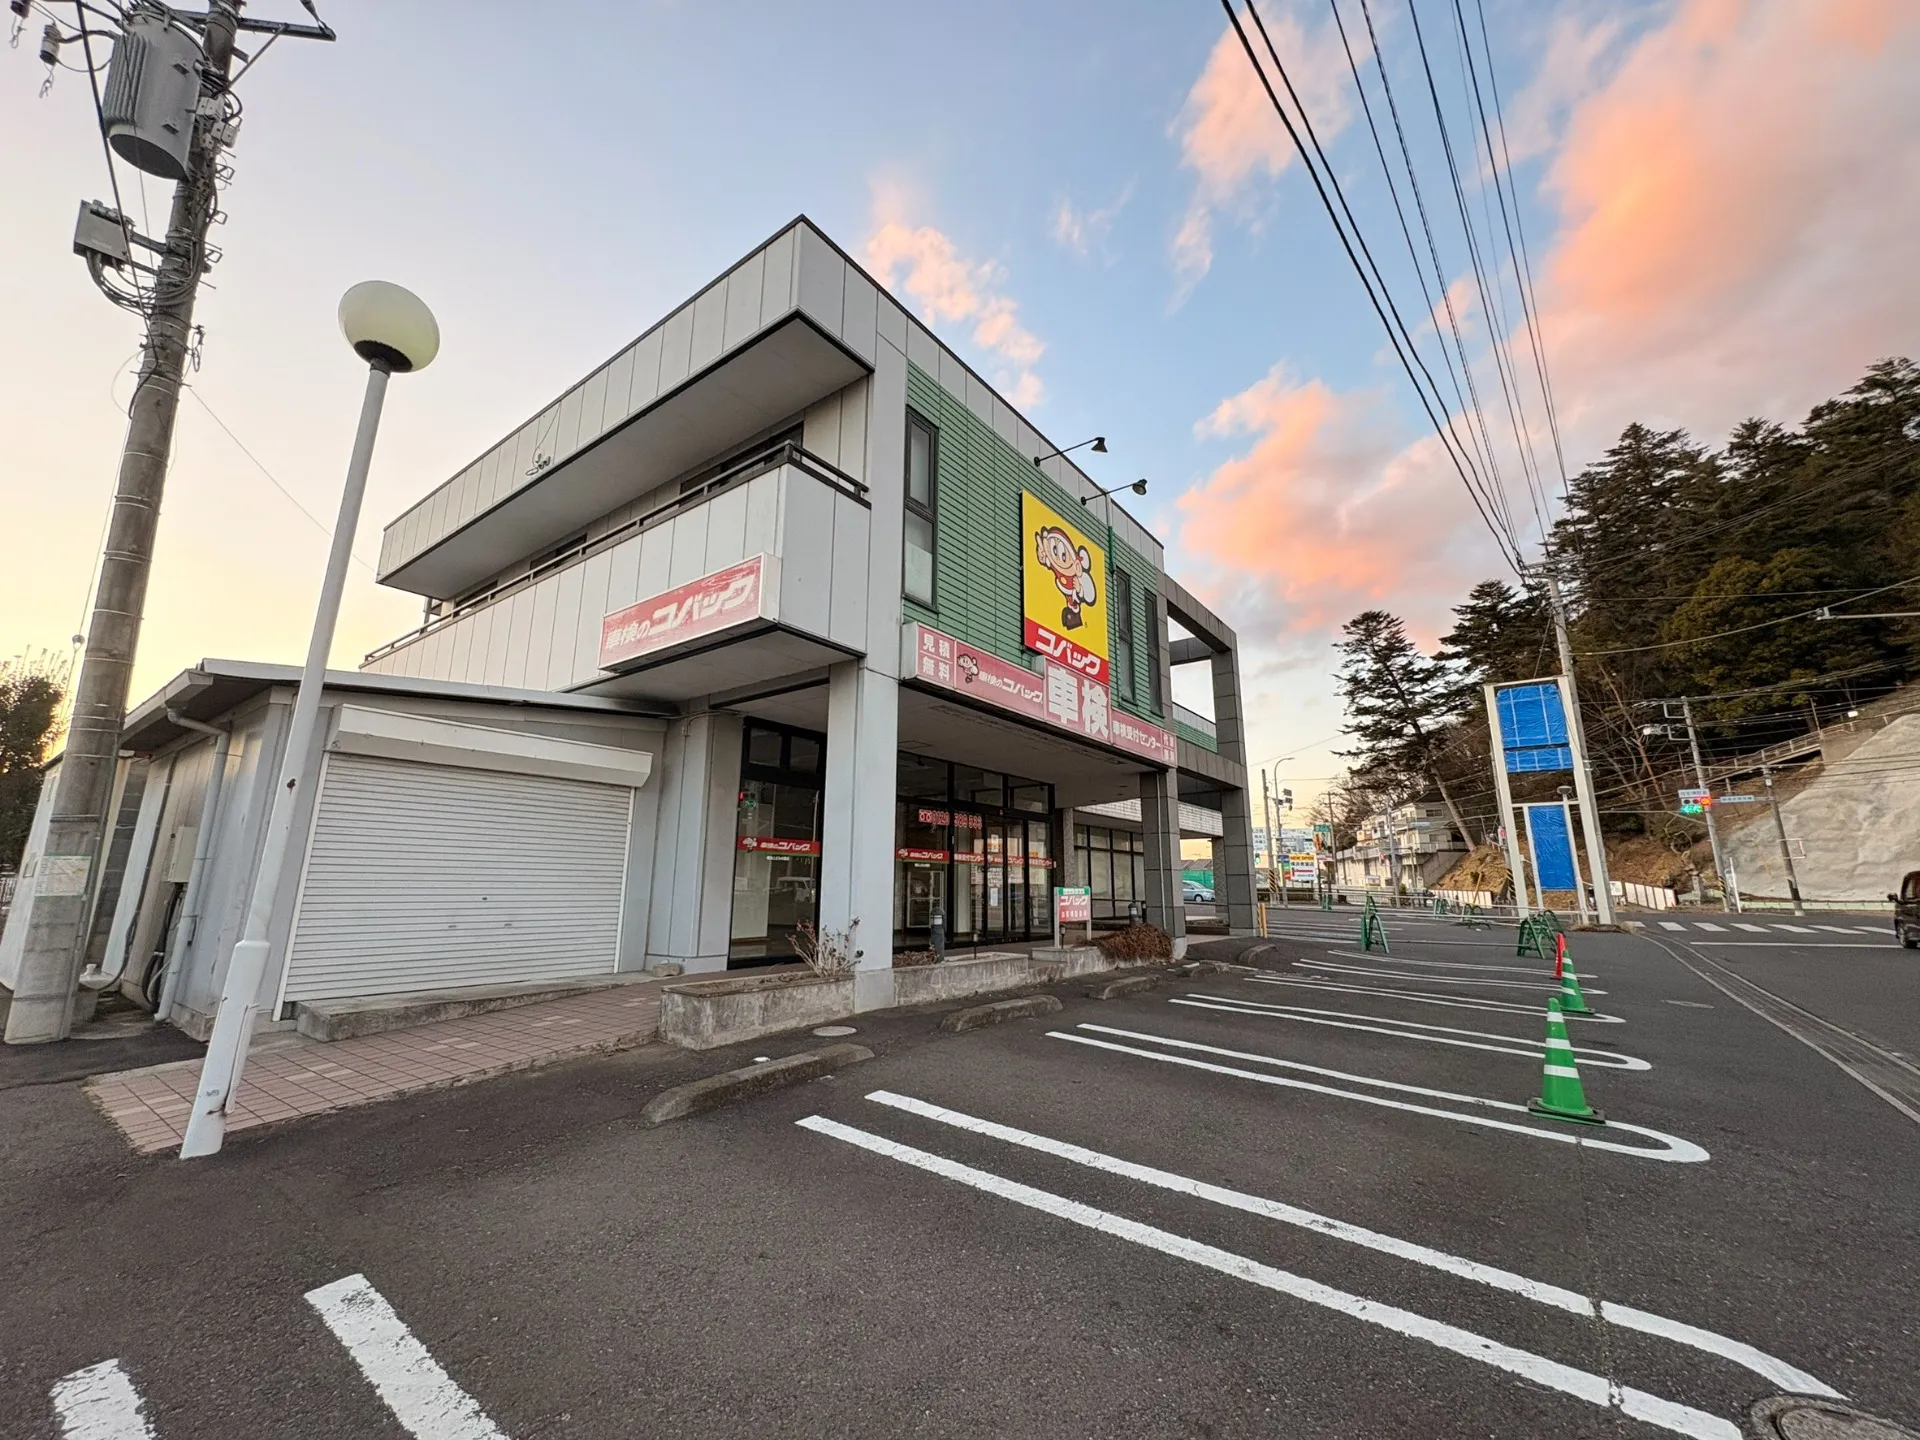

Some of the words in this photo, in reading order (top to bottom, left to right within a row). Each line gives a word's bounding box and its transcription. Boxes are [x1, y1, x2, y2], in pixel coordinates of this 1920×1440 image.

[923, 633, 950, 659] 見積
[1035, 628, 1101, 676] コバック
[922, 656, 950, 681] 無料
[978, 670, 1043, 703] 車検のコバック
[1047, 665, 1110, 739] 車検
[1060, 896, 1088, 906] コバック
